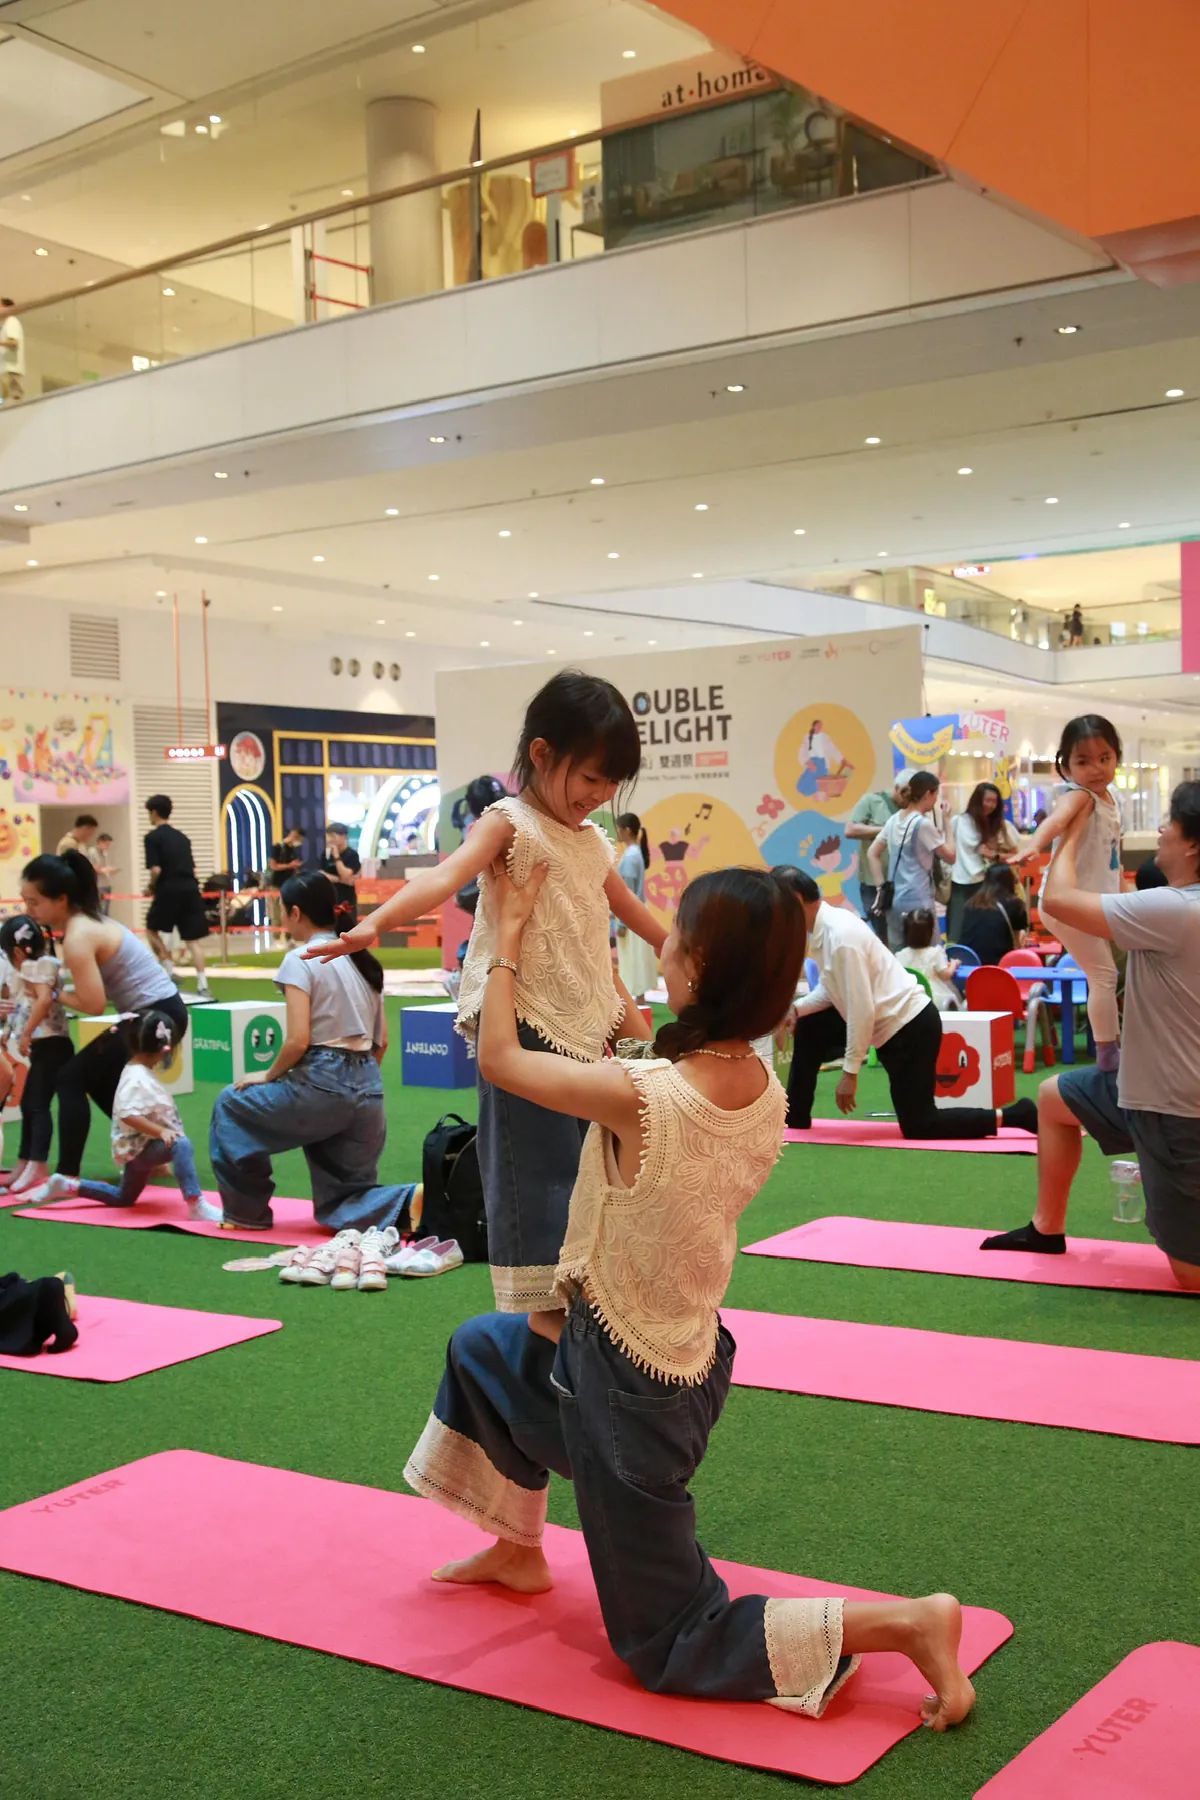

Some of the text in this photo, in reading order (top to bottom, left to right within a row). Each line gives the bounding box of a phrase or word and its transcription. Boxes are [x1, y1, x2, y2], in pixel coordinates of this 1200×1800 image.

[632, 684, 725, 716] OUBLE
[635, 714, 733, 746] ELIGHT
[961, 712, 1010, 742] YUTER
[405, 1041, 449, 1056] CONTENT
[30, 1479, 127, 1514] YUTER
[1072, 1697, 1159, 1756] YUTER
